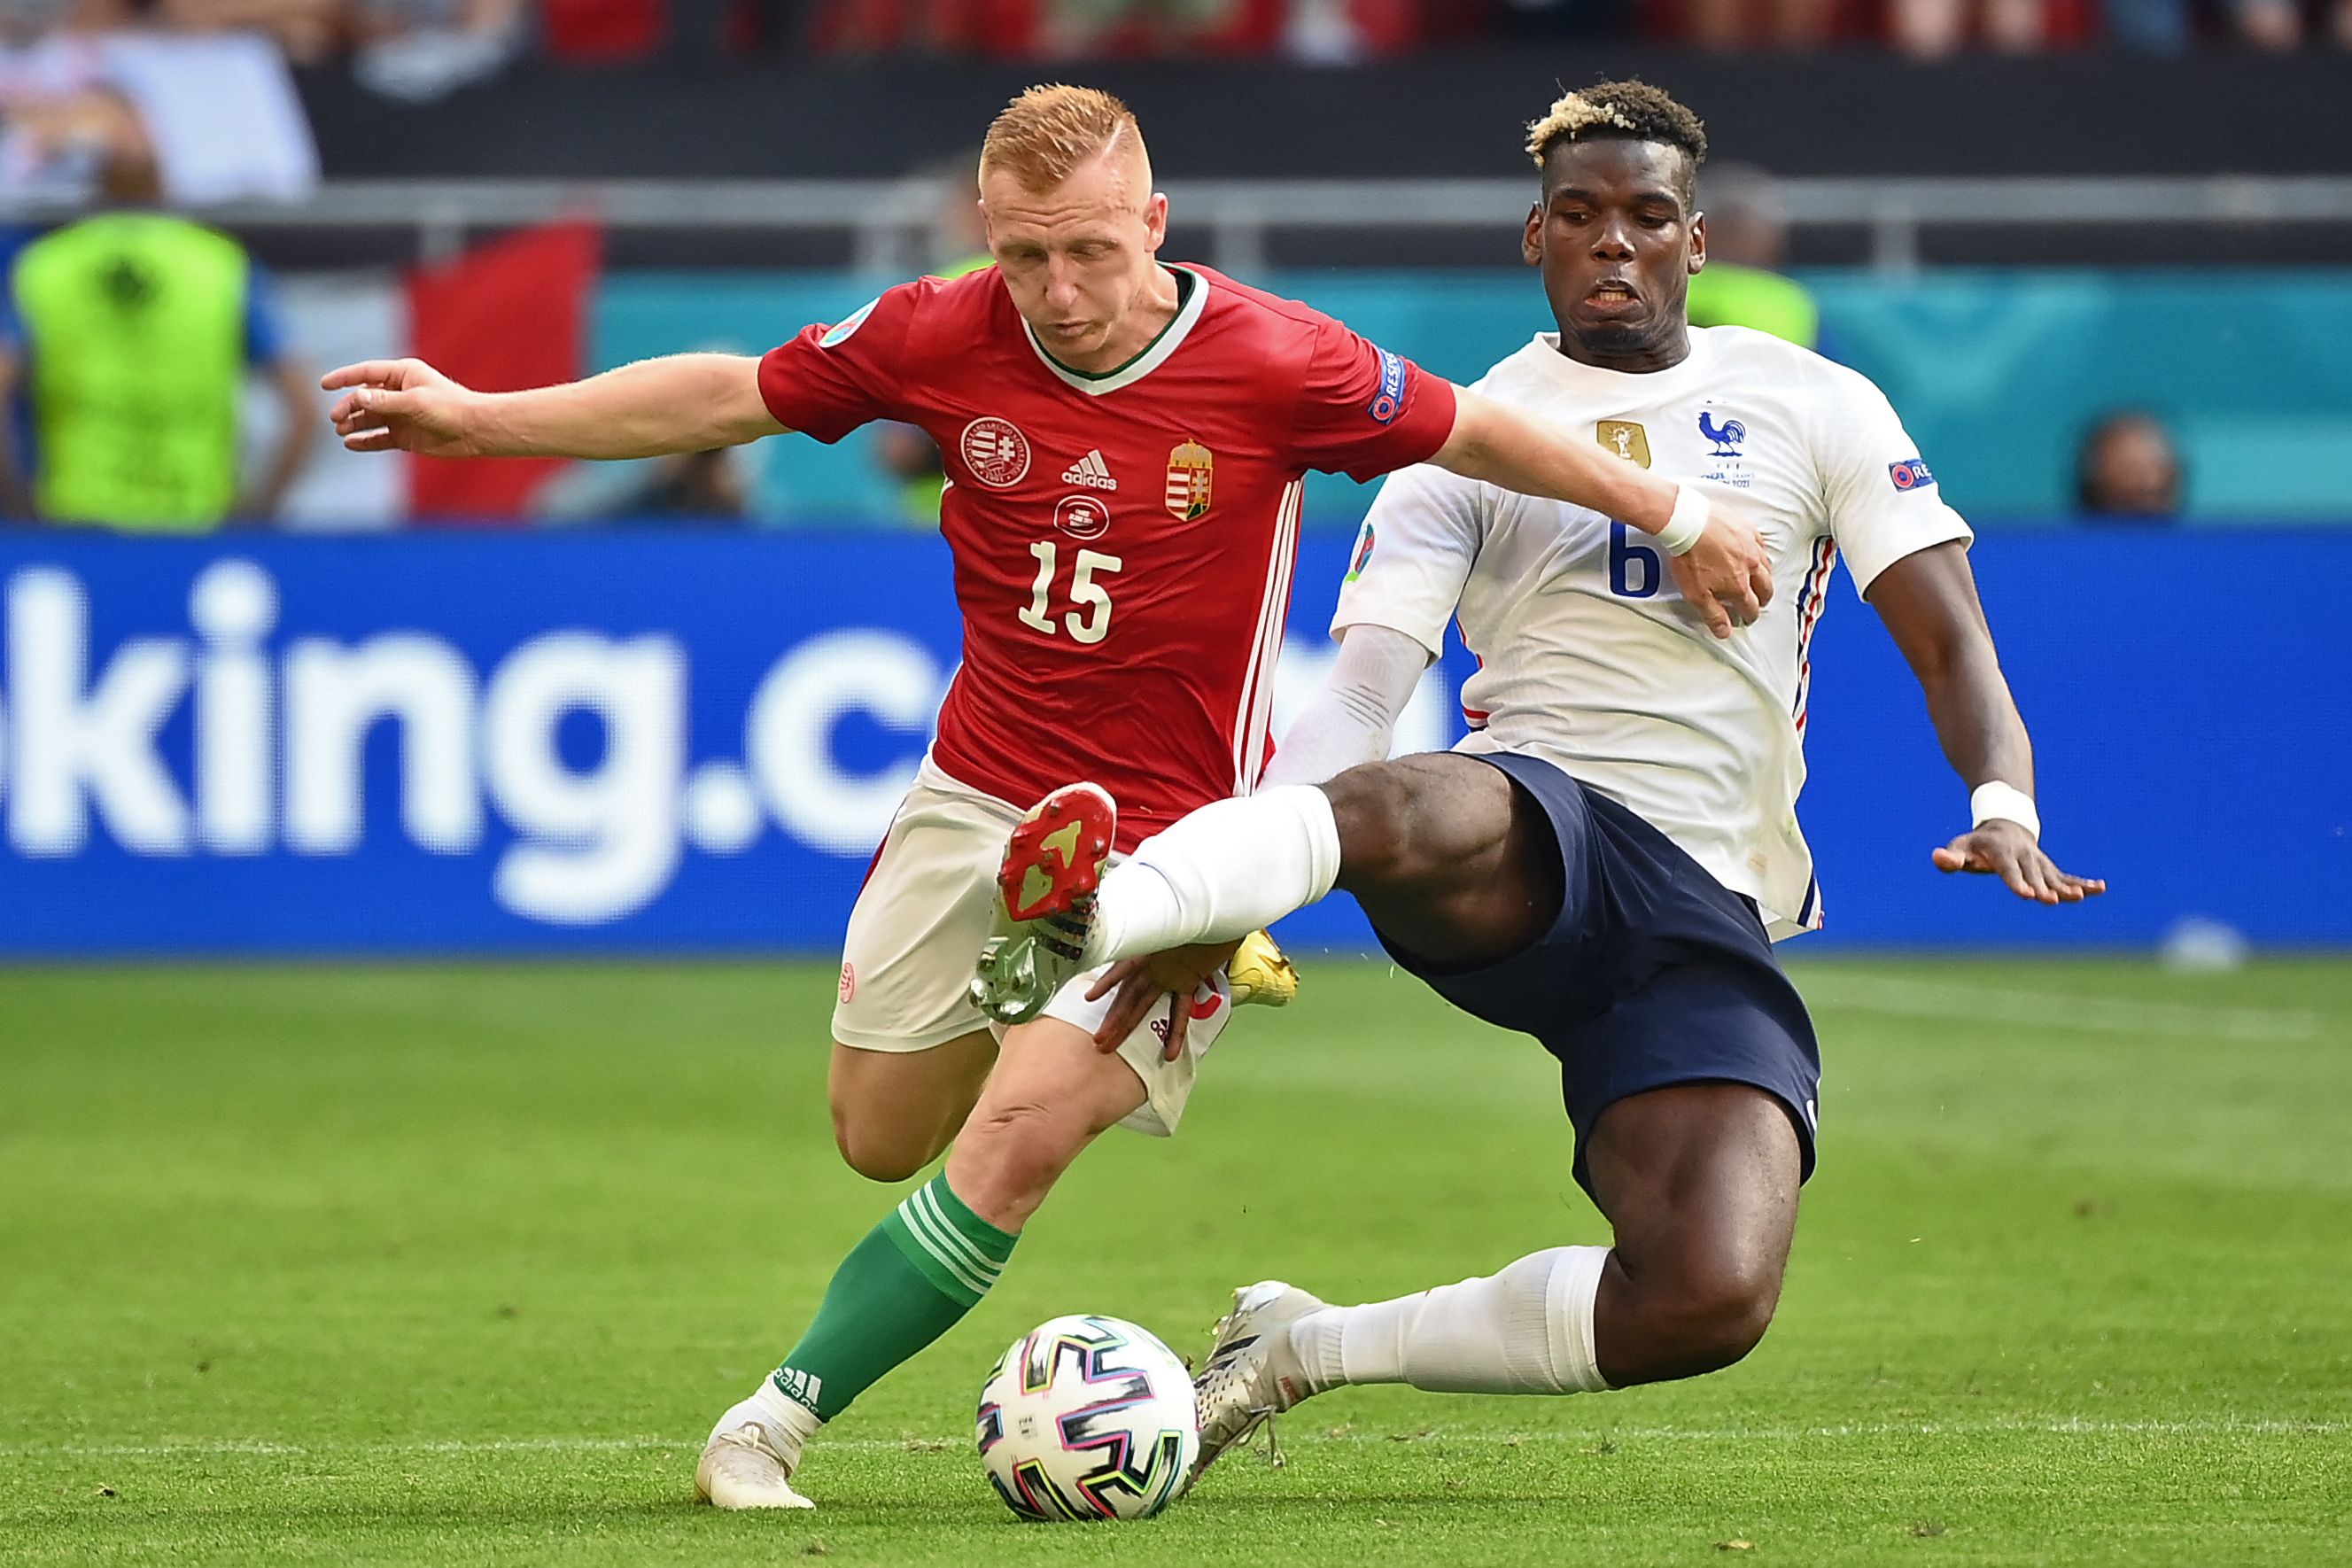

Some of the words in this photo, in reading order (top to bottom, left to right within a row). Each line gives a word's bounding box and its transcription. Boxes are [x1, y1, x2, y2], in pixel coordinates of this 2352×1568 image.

[1061, 471, 1117, 491] adidas
[1019, 540, 1122, 643] 15
[1609, 519, 1661, 599] 6
[0, 558, 961, 926] king.c
